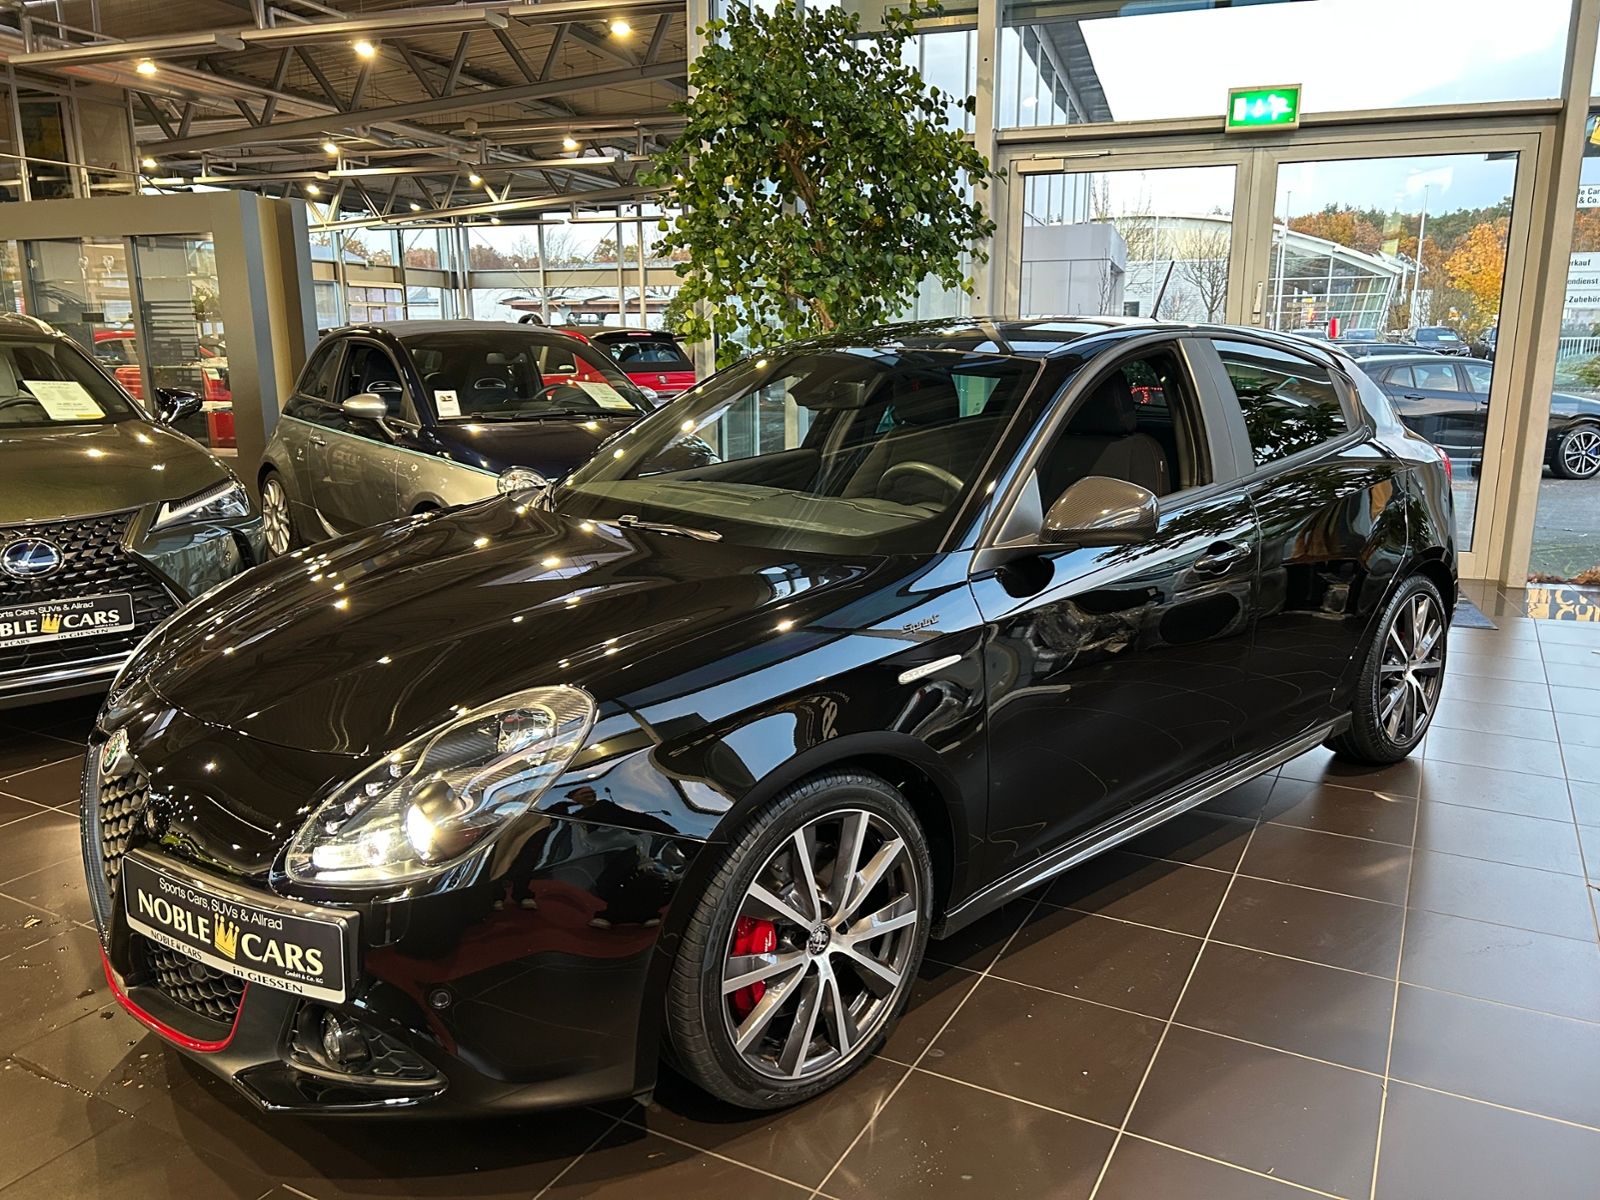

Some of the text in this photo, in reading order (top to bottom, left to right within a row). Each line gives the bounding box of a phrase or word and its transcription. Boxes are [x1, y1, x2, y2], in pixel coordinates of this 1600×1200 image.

[38, 605, 62, 614] SUVs
[71, 601, 94, 610] Allrad
[0, 609, 120, 637] BLE CARS
[159, 878, 283, 930] Sports Cars, SUVs & Allrad
[138, 888, 323, 976] NOBLE CARS
[150, 930, 202, 960] NOBLE CARS
[232, 966, 303, 994] in GIESSEN
